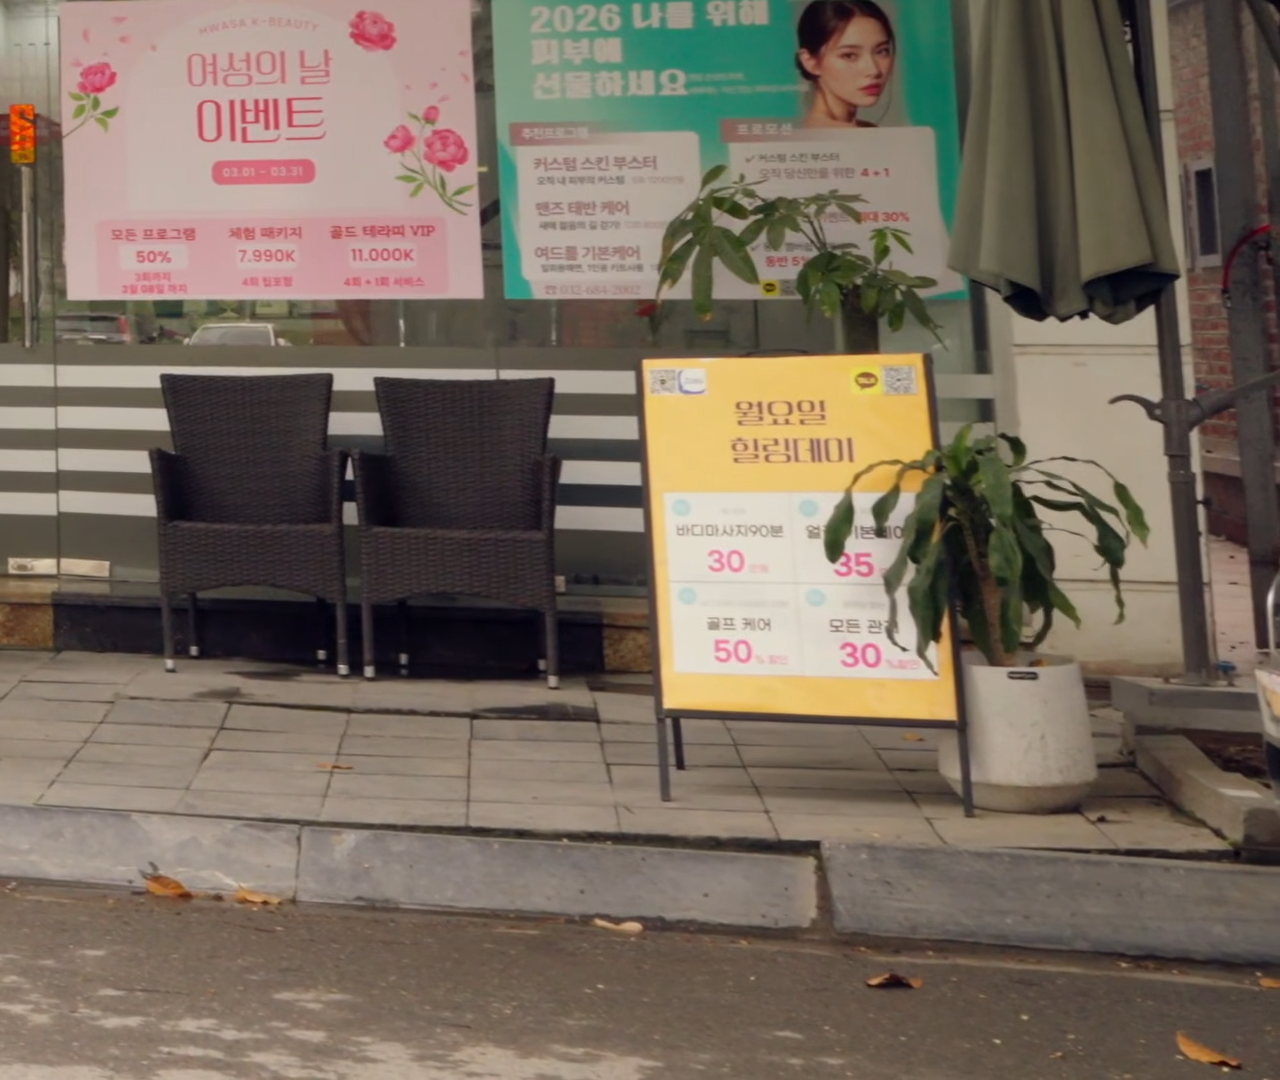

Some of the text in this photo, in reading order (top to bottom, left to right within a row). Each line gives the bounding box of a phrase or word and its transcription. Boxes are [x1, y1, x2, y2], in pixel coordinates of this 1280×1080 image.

[530, 3, 622, 34] 2026
[632, 1, 694, 29] 나를
[198, 16, 319, 36] HWASA K-BEAUTY
[531, 37, 623, 65] 피부에
[187, 49, 333, 87] 여성의 날
[533, 69, 688, 100] 선물하세요
[196, 96, 327, 144] 이벤트
[737, 123, 793, 135] 프로모션
[534, 155, 658, 172] 커스텀 스킨 부스터
[759, 153, 840, 163] 커스텀 스킨 부스터
[222, 167, 256, 178] 03.01
[271, 166, 304, 177] 03.31
[760, 168, 782, 180] 오직
[601, 200, 630, 215] 케어
[882, 211, 910, 222] 30%
[111, 228, 196, 241] 모든 프로그램
[260, 226, 302, 240] 패키지
[330, 224, 436, 239] 골드 테라피 VIP
[135, 250, 172, 263] 50%
[238, 249, 296, 263] 7.990K
[351, 248, 414, 262] 11.000K
[535, 245, 641, 261] 여드름 기본케어
[735, 400, 828, 426] 월요일
[731, 437, 855, 464] 힐링데이
[676, 524, 784, 538] 바디마사지90분
[708, 549, 746, 573] 30
[833, 552, 875, 578] 35
[741, 617, 772, 631] 케어
[830, 619, 860, 633] 모든
[714, 639, 753, 663] 50
[840, 642, 882, 668] 30
